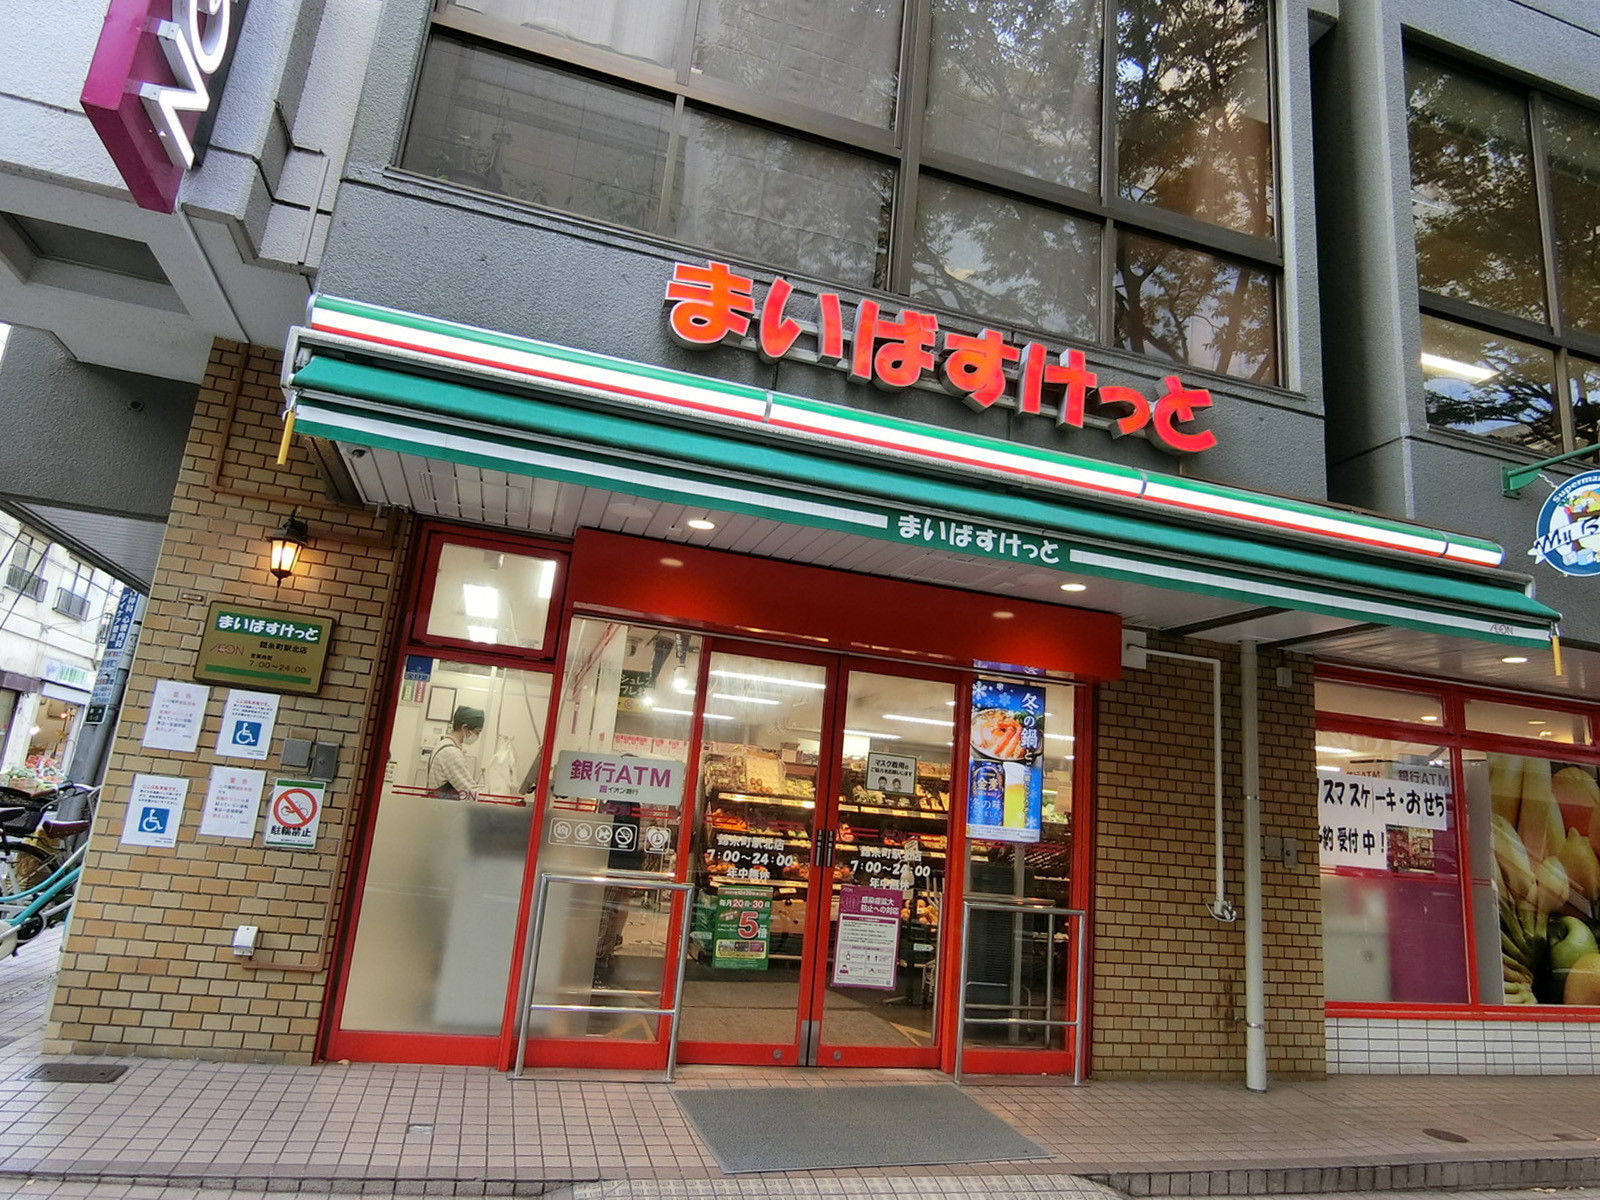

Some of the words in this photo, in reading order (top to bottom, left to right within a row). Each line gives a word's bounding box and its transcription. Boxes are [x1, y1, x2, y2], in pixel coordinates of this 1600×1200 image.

[665, 261, 1218, 455] まいばすけっと
[898, 515, 1060, 564] まいばすけっと
[1534, 529, 1571, 554] My
[218, 615, 319, 641] まいばすけっと
[259, 641, 307, 654] 錦糸町駅北店
[875, 759, 909, 769] マスク着用の
[569, 759, 672, 788] 銀行ATM
[1398, 769, 1450, 788] 銀行ATM
[608, 787, 638, 795] イオン銀行
[271, 825, 312, 838] 駐輪禁止
[706, 849, 793, 866] 7:00～24:00
[727, 866, 770, 881] 年中無休
